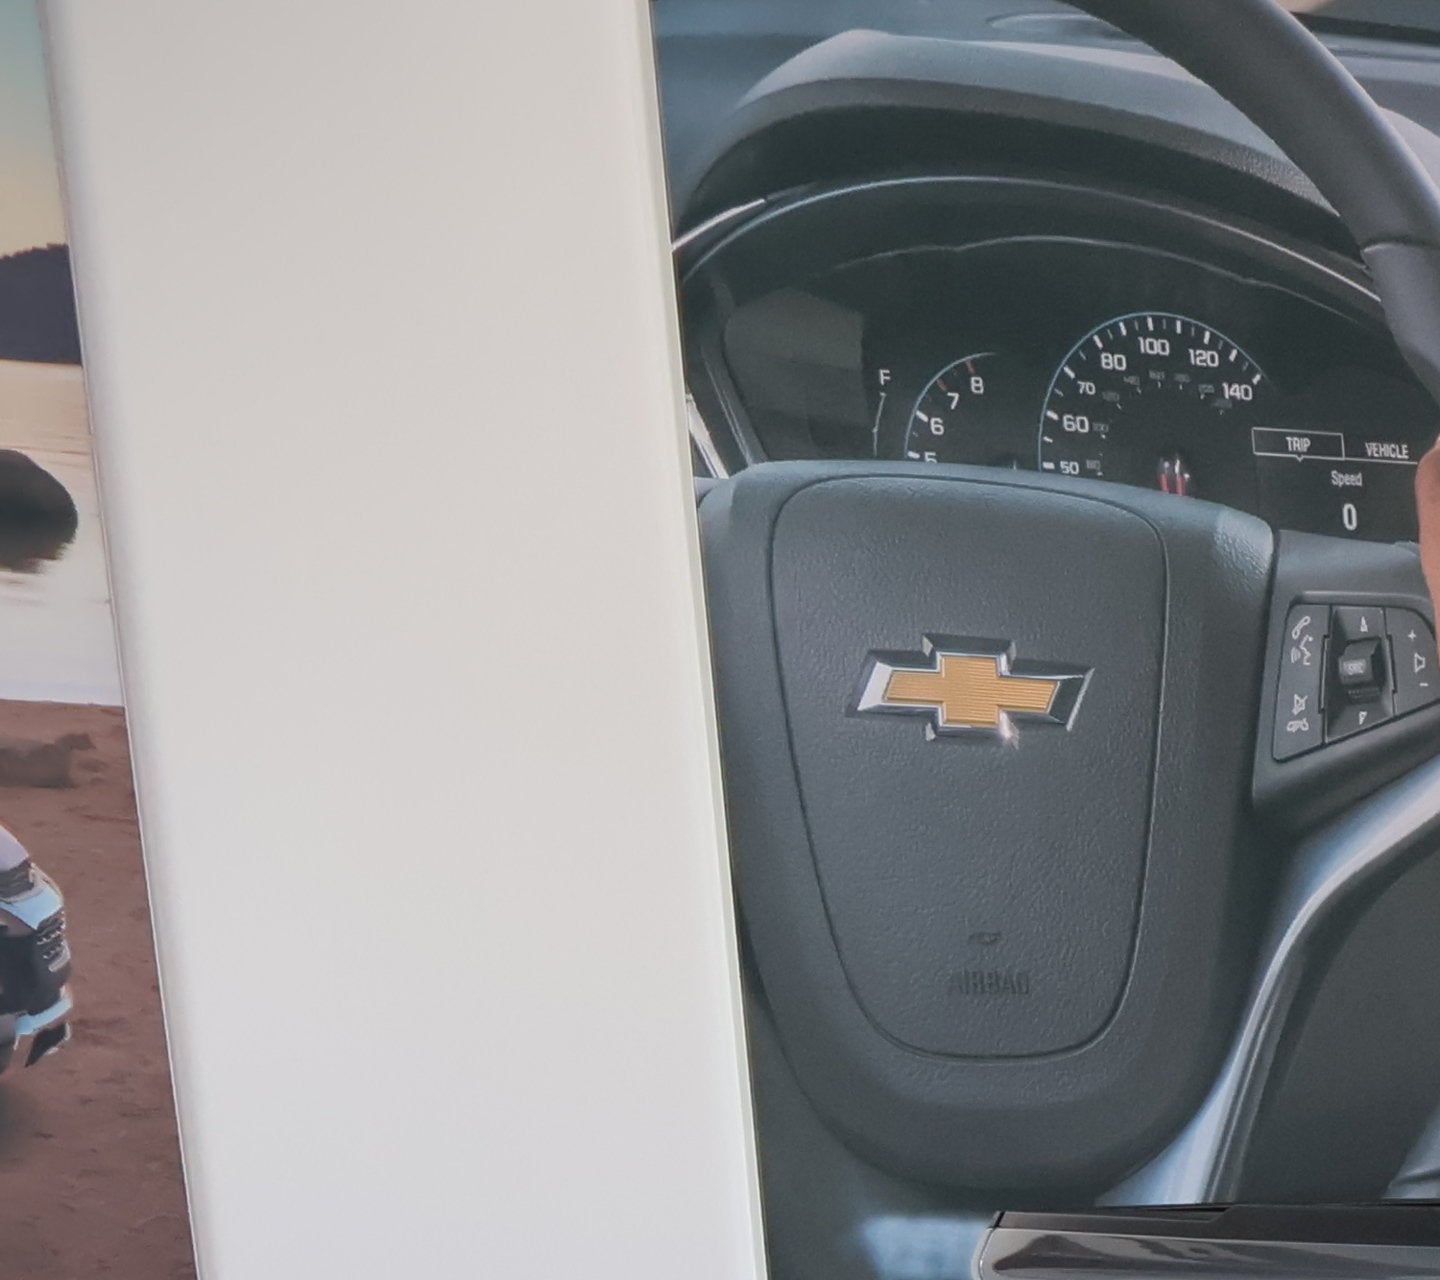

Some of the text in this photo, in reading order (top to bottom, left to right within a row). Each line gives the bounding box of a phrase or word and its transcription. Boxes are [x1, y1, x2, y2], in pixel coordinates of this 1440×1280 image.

[1138, 336, 1170, 356] 100
[1101, 352, 1127, 371] 80
[1188, 348, 1219, 368] 120
[880, 369, 891, 385] F
[970, 377, 984, 395] 8
[1077, 381, 1096, 396] 70
[1222, 382, 1253, 401] 140
[947, 393, 960, 410] 7
[930, 418, 945, 435] 6
[1062, 415, 1089, 433] 60
[1285, 436, 1409, 460] TRIP VEHICLE
[1059, 461, 1080, 475] 50
[1330, 469, 1363, 488] Speed
[1342, 503, 1358, 531] 0
